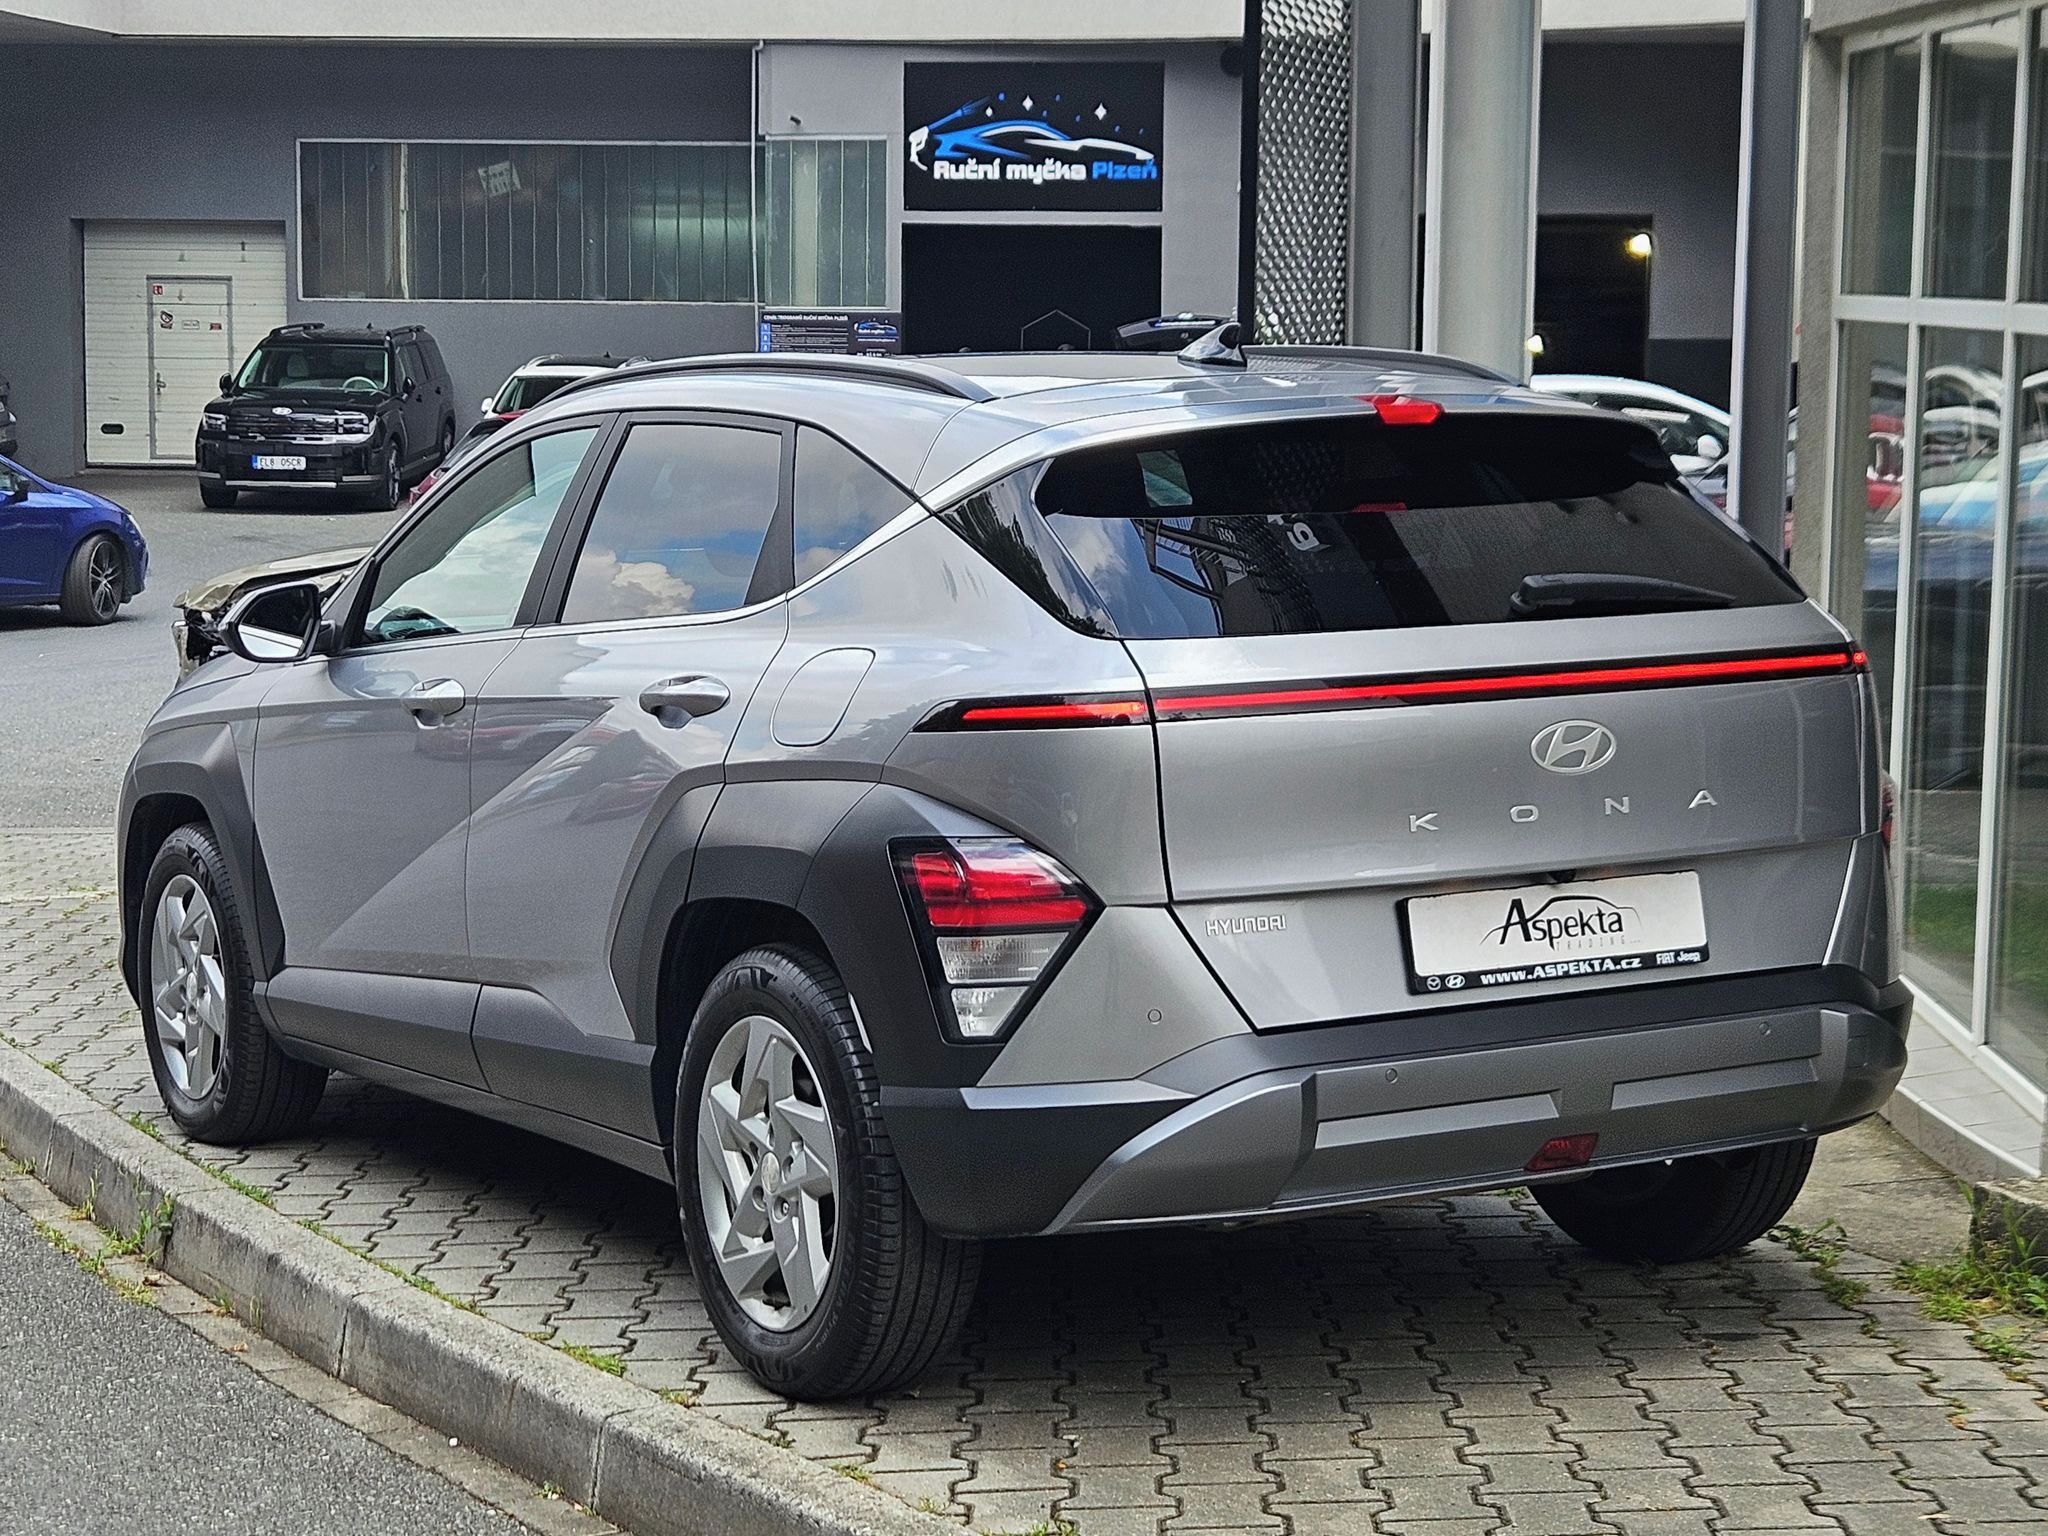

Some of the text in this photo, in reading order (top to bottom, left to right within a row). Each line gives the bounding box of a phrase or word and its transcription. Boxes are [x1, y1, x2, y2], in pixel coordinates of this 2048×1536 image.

[933, 158, 1158, 185] Ruční myčka Plzeň
[1408, 789, 1718, 833] KONA
[1205, 914, 1287, 936] HYUNDAI
[1499, 897, 1624, 951] Aspekta
[1480, 950, 1701, 985] www.ASPEKTA.cz FIAT Jeep
